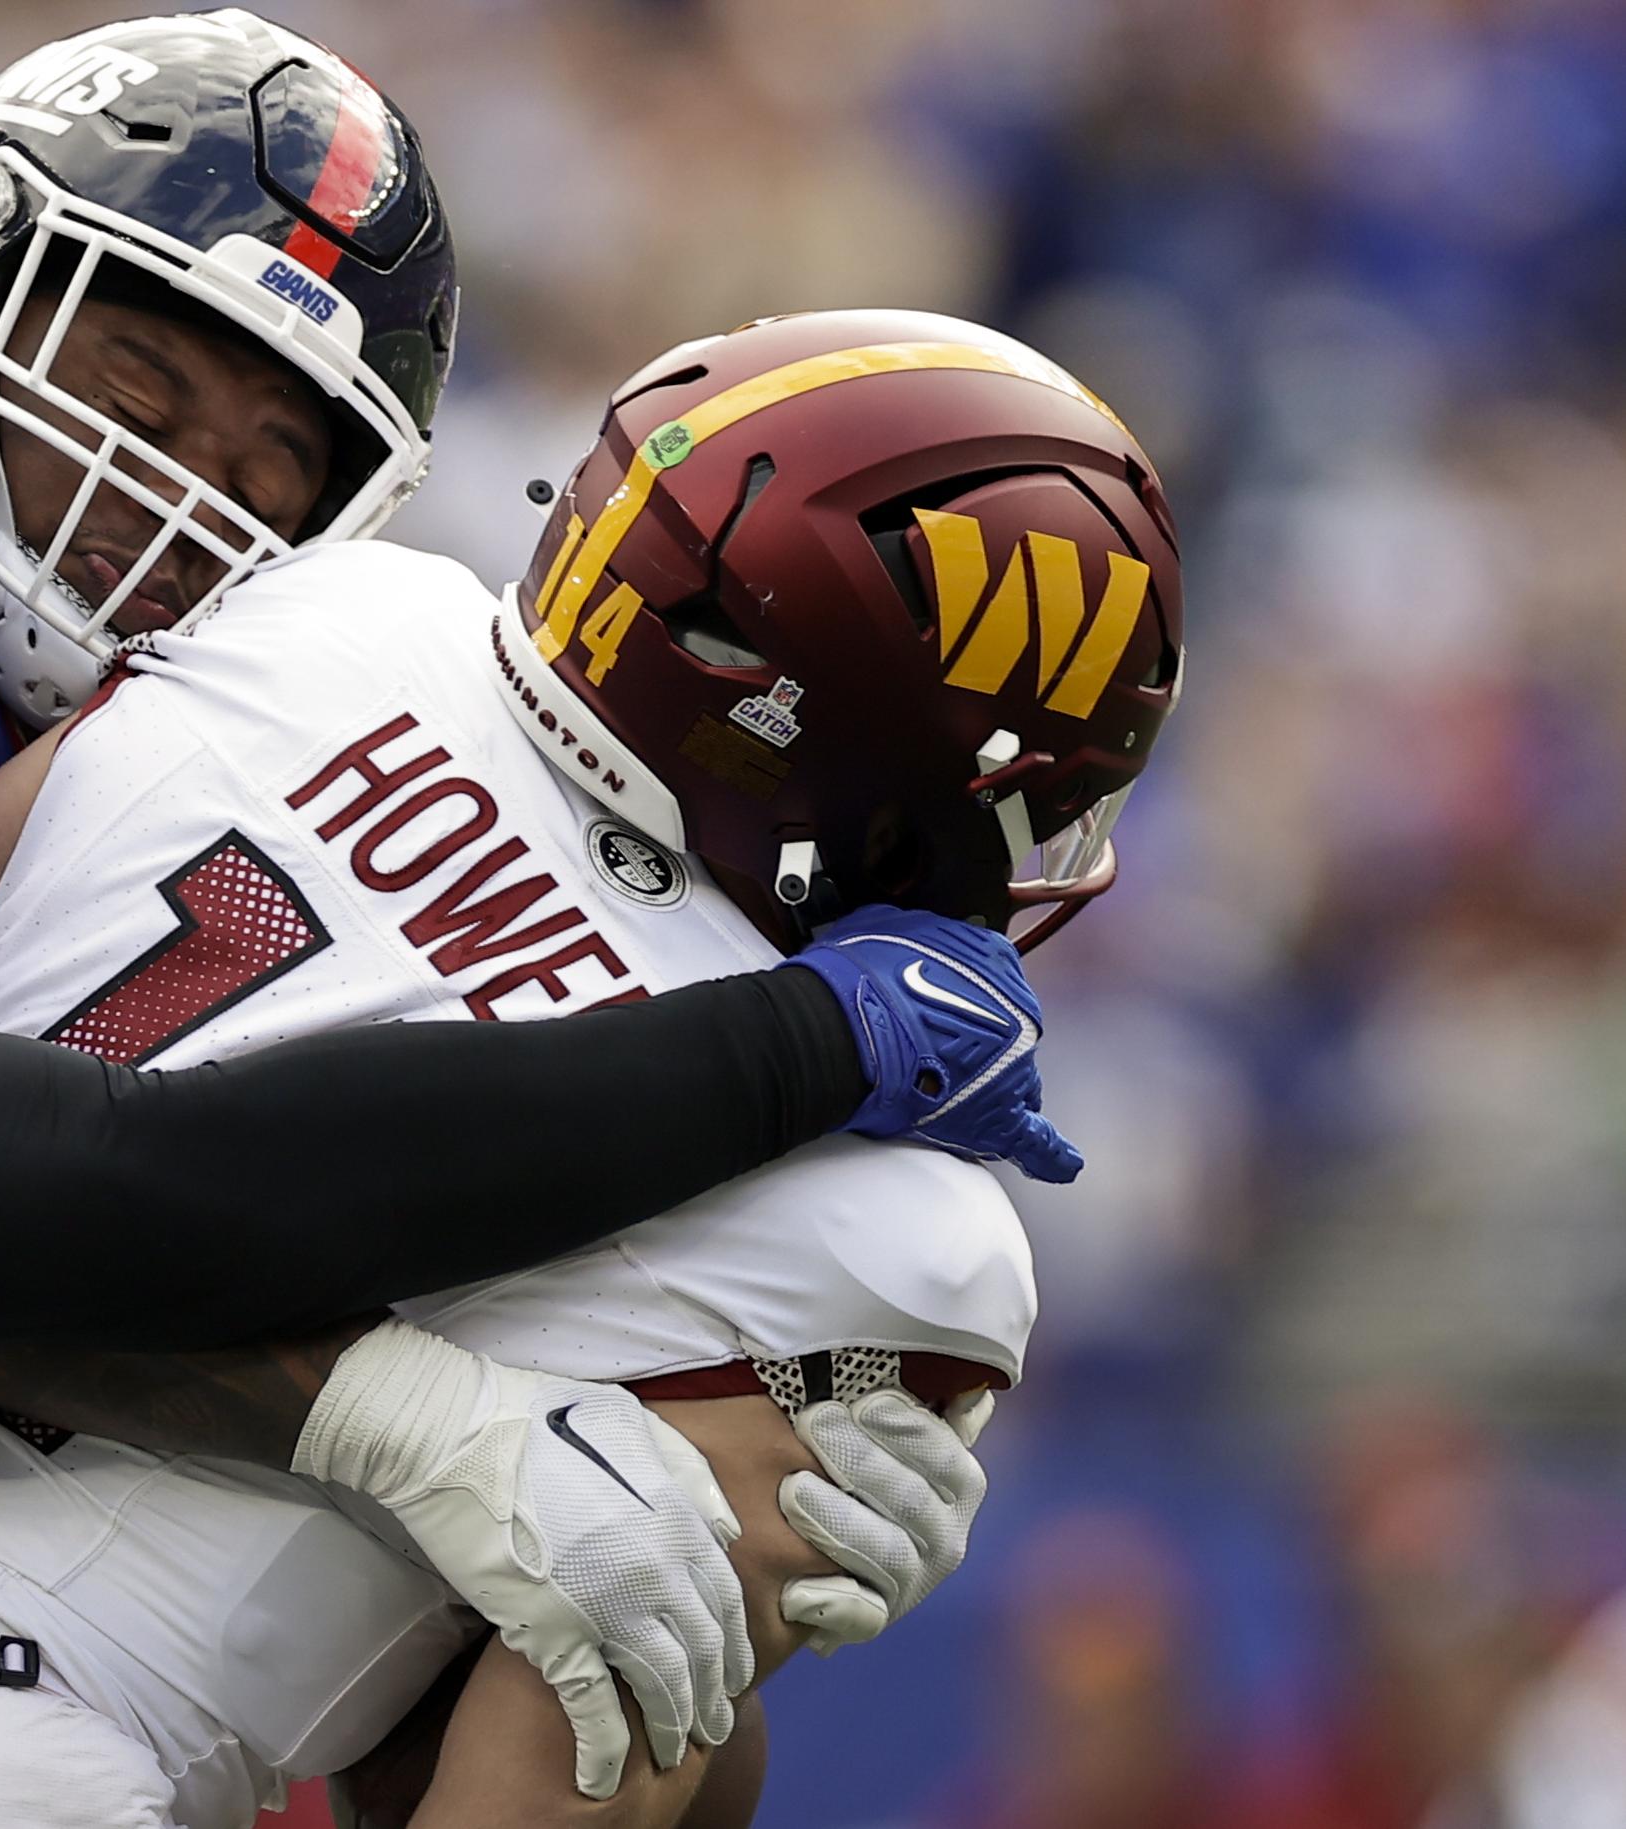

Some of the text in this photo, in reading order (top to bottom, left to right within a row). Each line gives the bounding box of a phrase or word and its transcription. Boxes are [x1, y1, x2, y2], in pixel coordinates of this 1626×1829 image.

[261, 259, 340, 322] GIANTS
[737, 701, 797, 740] CATCH
[284, 711, 651, 1021] HOWE
[38, 828, 334, 1068] 1
